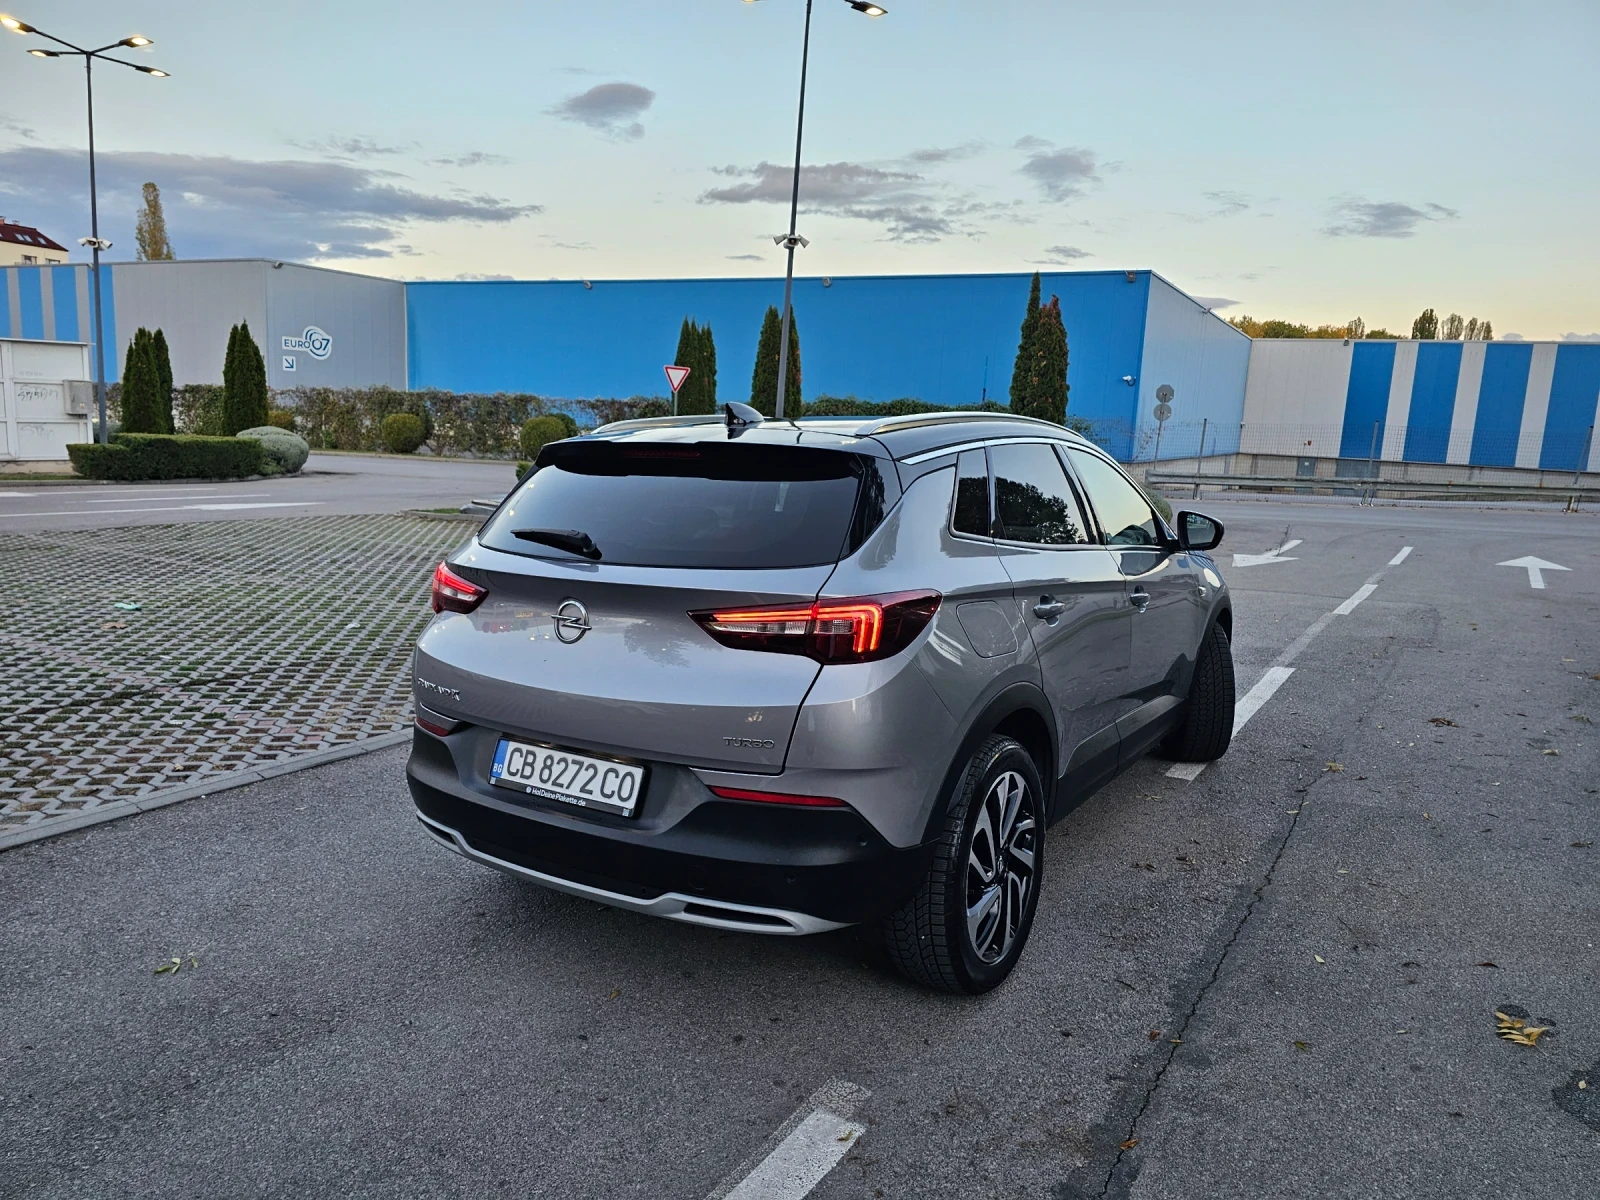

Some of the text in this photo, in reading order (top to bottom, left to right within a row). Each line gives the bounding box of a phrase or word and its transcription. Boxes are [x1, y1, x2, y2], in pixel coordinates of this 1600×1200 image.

[284, 339, 310, 349] EURO
[722, 736, 775, 749] TURBO
[493, 763, 503, 773] BG
